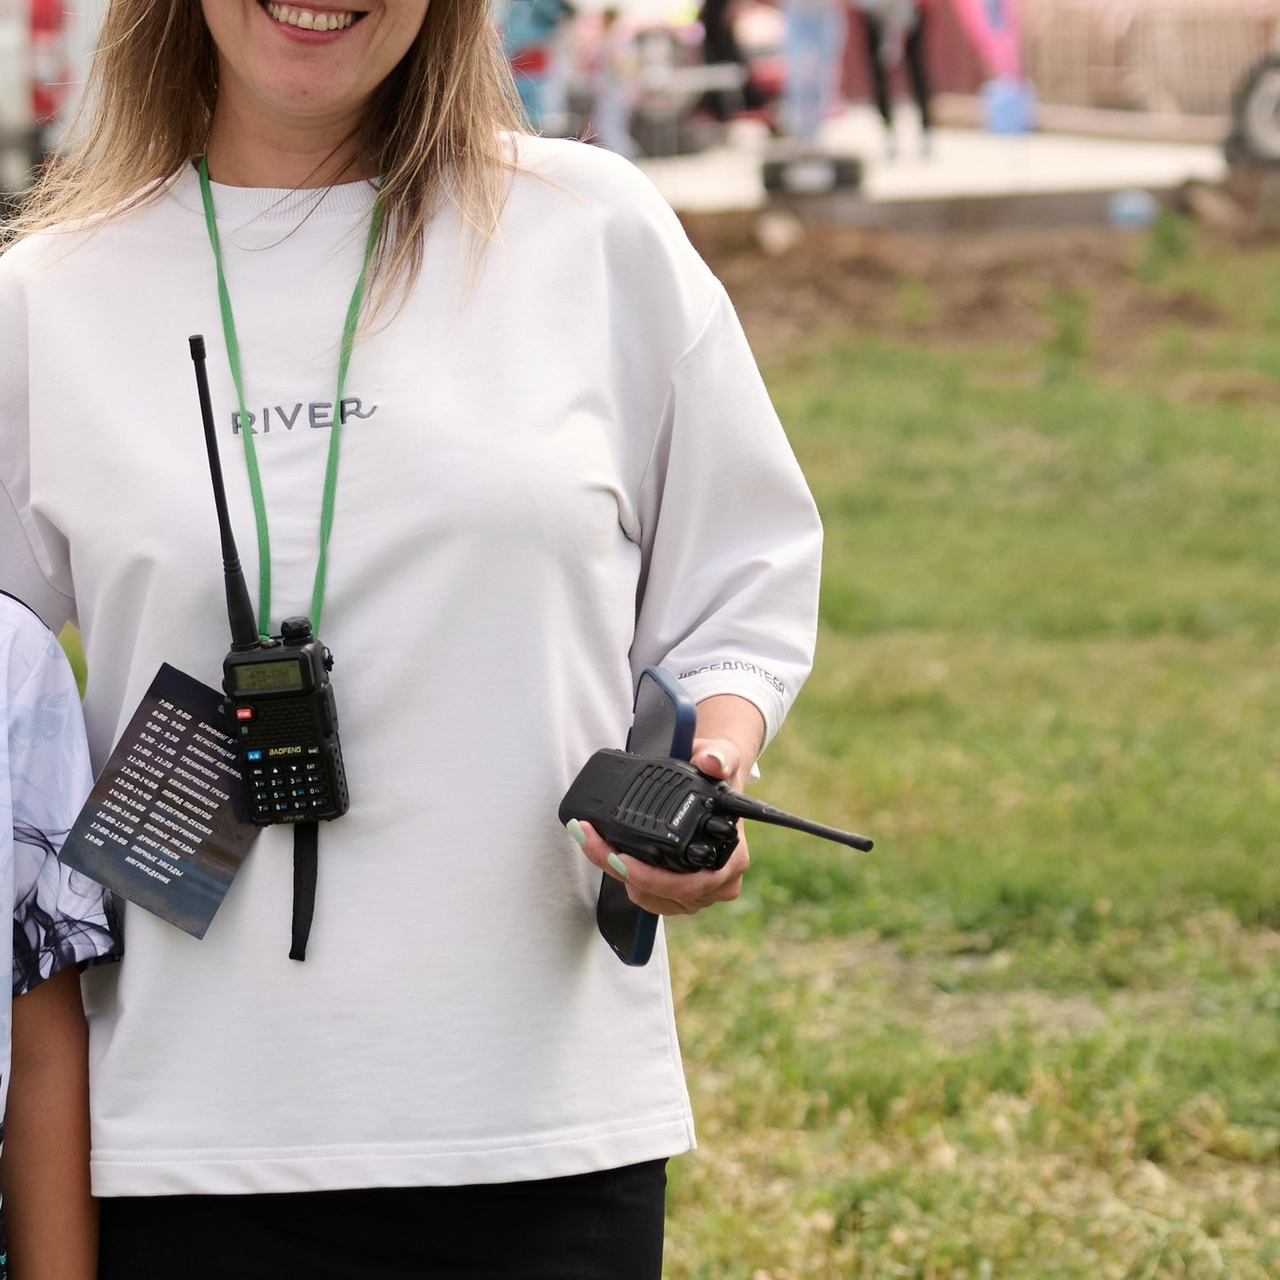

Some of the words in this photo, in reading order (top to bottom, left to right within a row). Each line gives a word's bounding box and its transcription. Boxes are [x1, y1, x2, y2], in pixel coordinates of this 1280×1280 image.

[231, 397, 378, 435] RIVER
[269, 746, 302, 756] BAOFENG
[673, 793, 696, 827] BAOFENG
